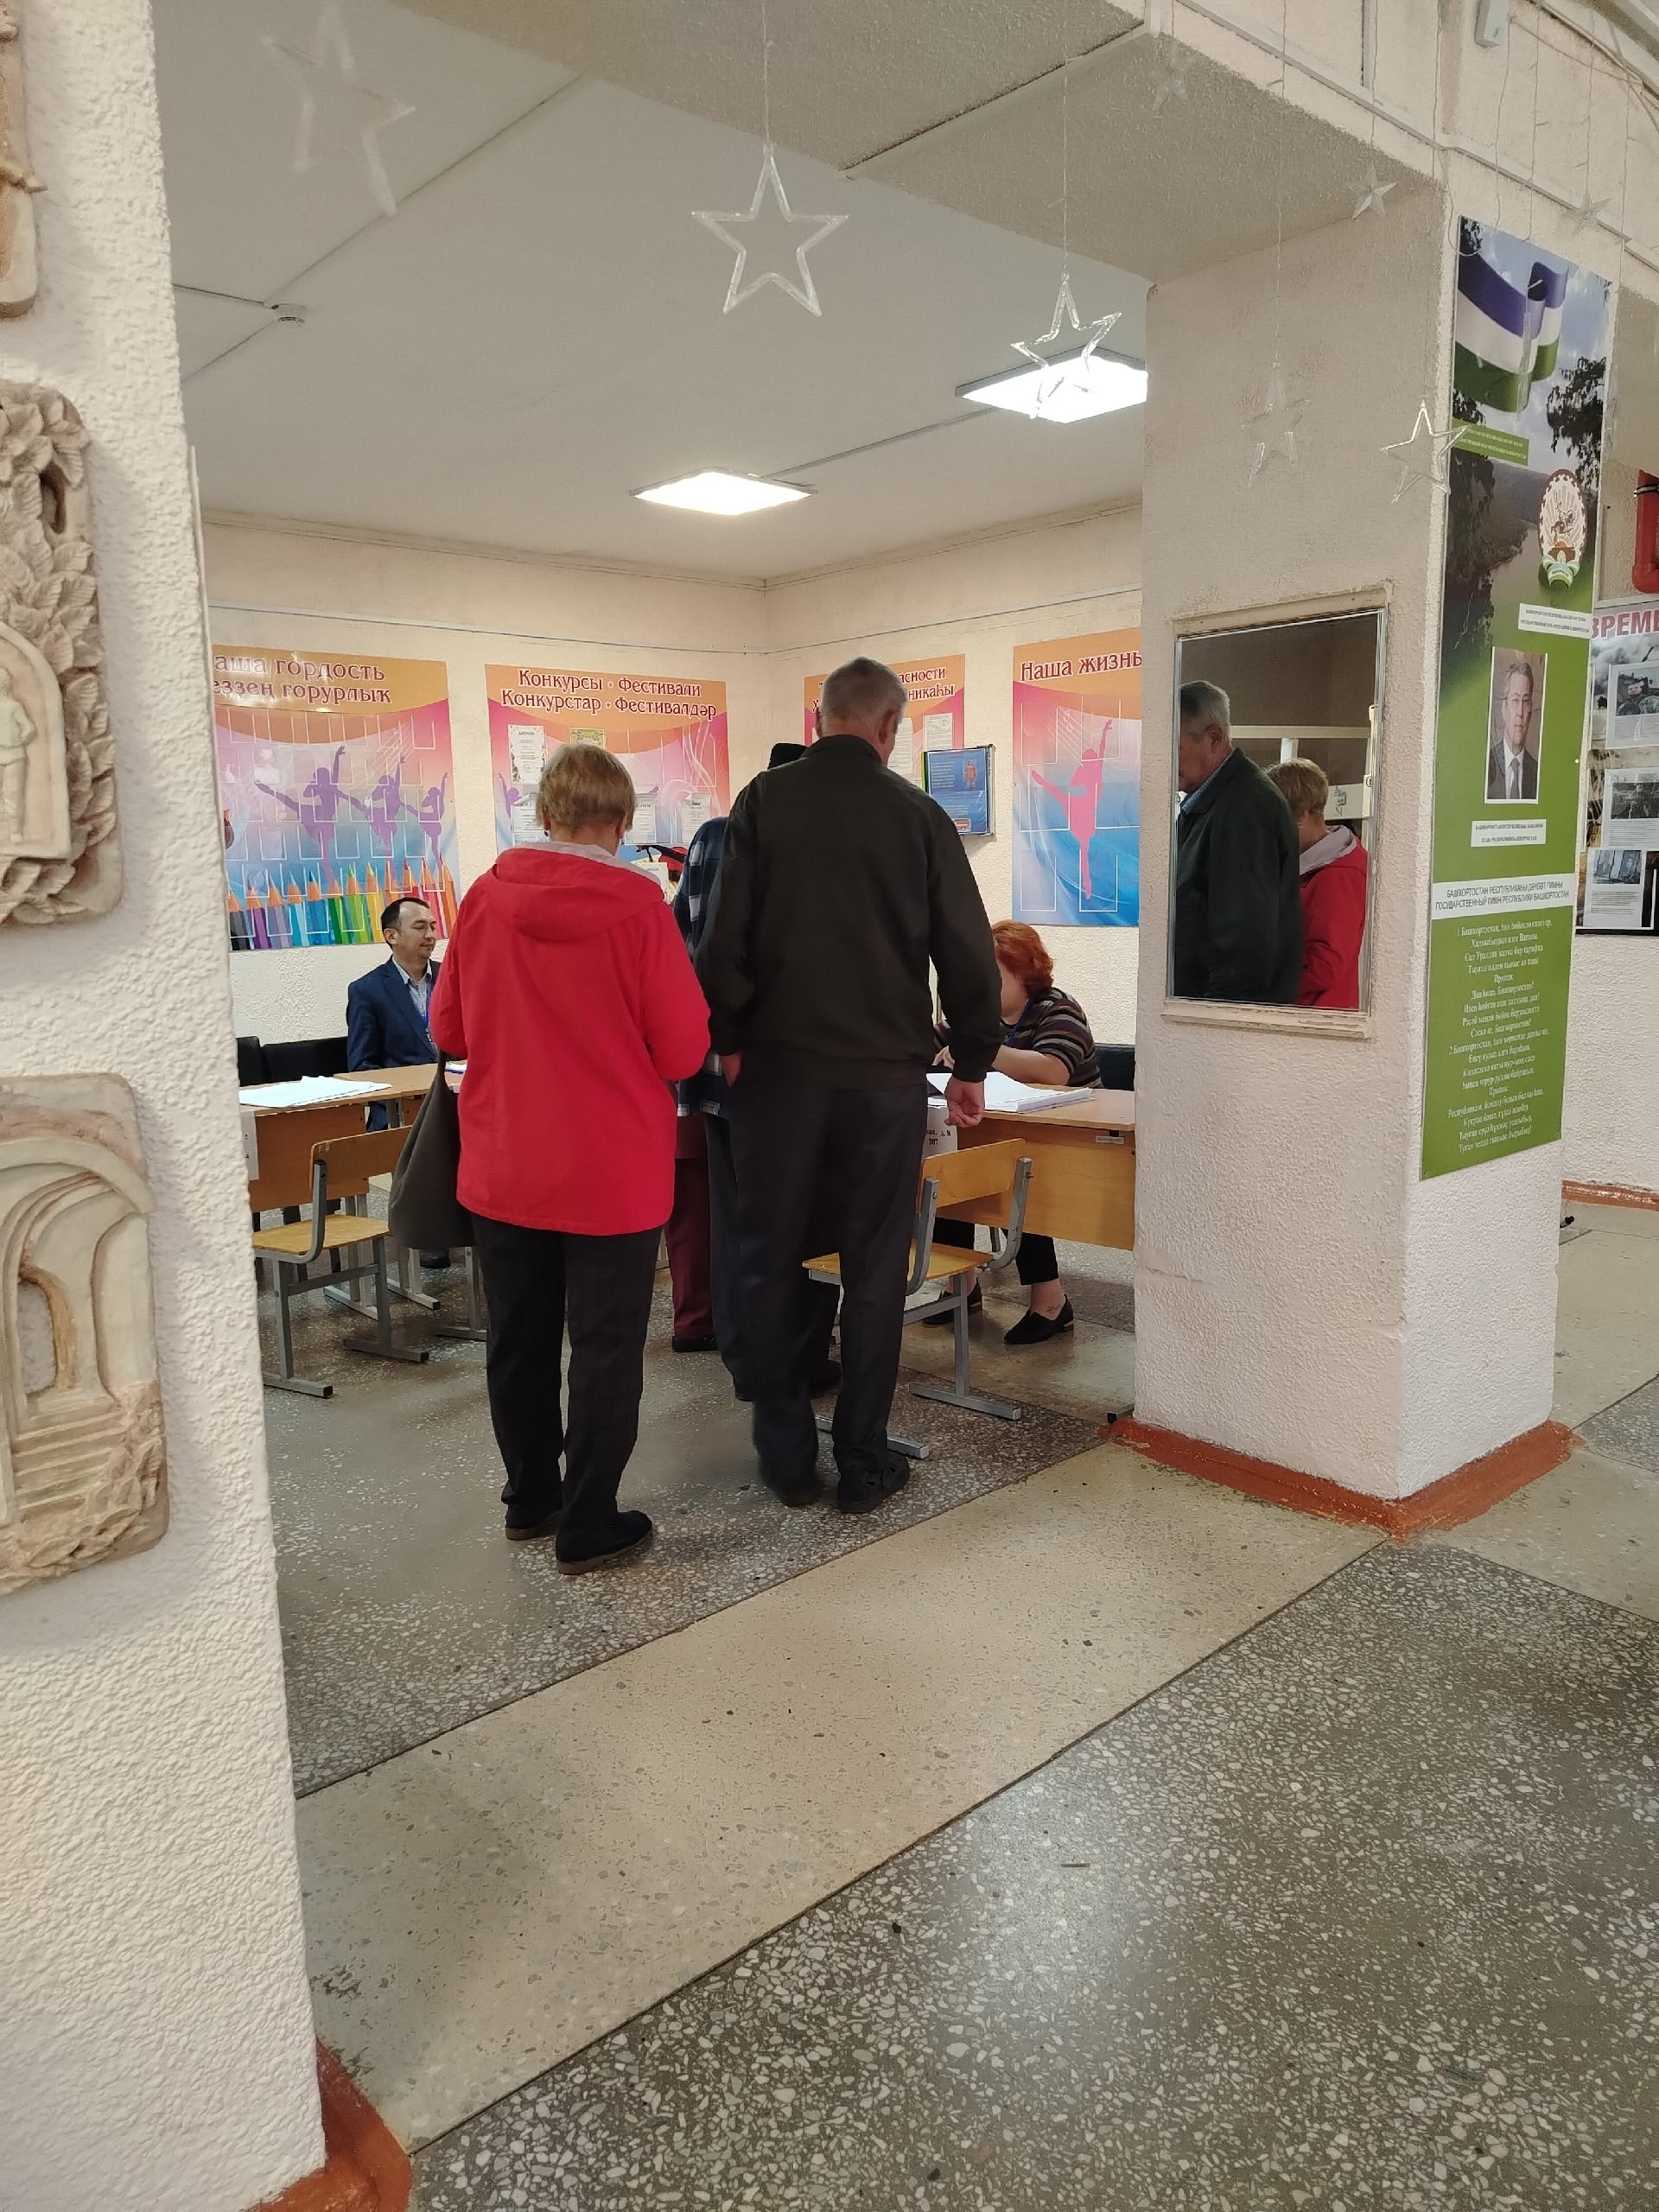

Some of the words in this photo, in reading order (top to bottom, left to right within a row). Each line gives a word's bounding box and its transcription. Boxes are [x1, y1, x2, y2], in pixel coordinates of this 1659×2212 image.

[214, 655, 266, 673] аша
[275, 658, 385, 681] гордость
[898, 668, 946, 683] асности
[1020, 660, 1073, 682] Наша
[1077, 650, 1142, 675] жизнь
[213, 678, 276, 702] еҙҙең
[518, 670, 603, 693] Конкурсы
[618, 677, 701, 697] Фестивали
[907, 684, 955, 702] никаһы
[501, 690, 601, 715] Конкурстар
[615, 696, 716, 721] Фестивалдәр
